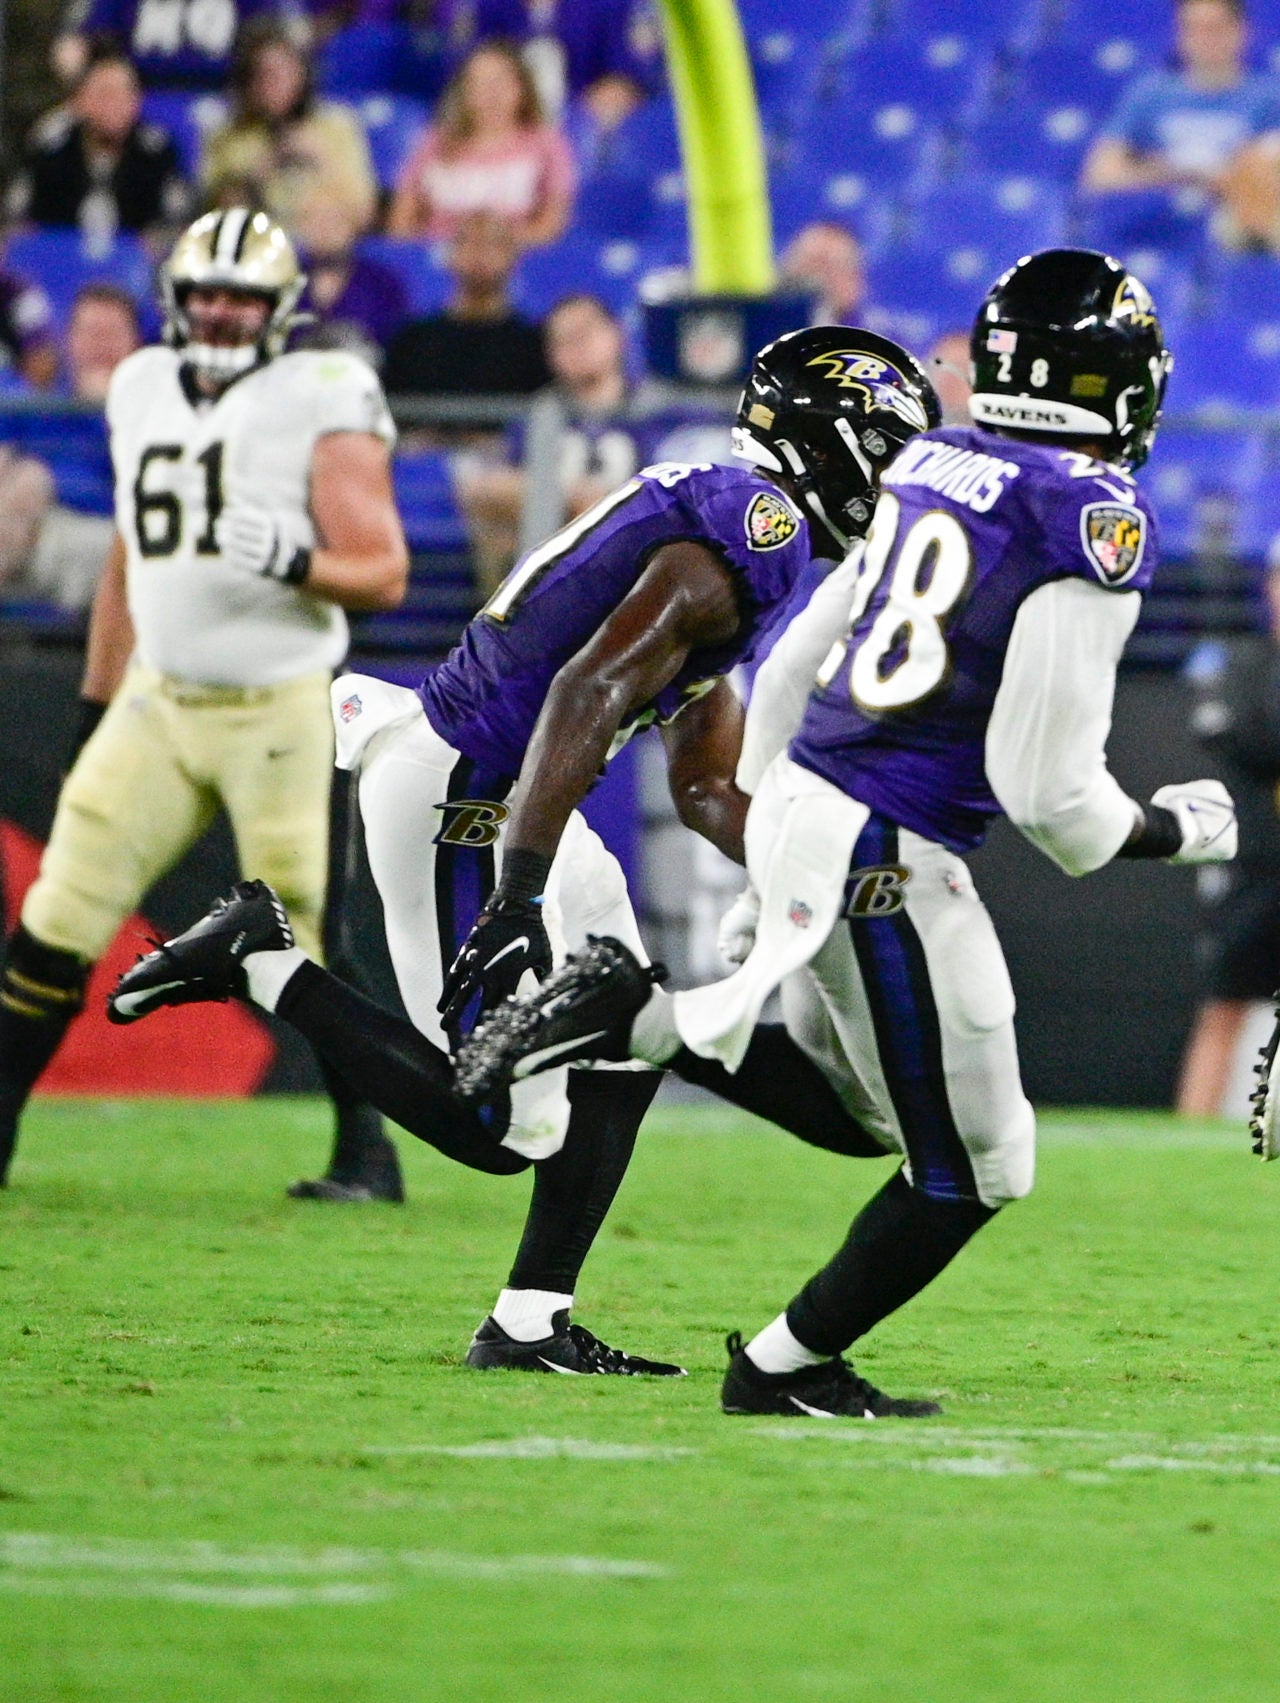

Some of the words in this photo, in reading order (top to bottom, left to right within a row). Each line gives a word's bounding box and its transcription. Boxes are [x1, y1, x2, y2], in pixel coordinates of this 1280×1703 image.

[980, 403, 1069, 426] RAVENS
[133, 439, 224, 559] 61
[431, 799, 511, 848] B
[841, 863, 912, 918] B
